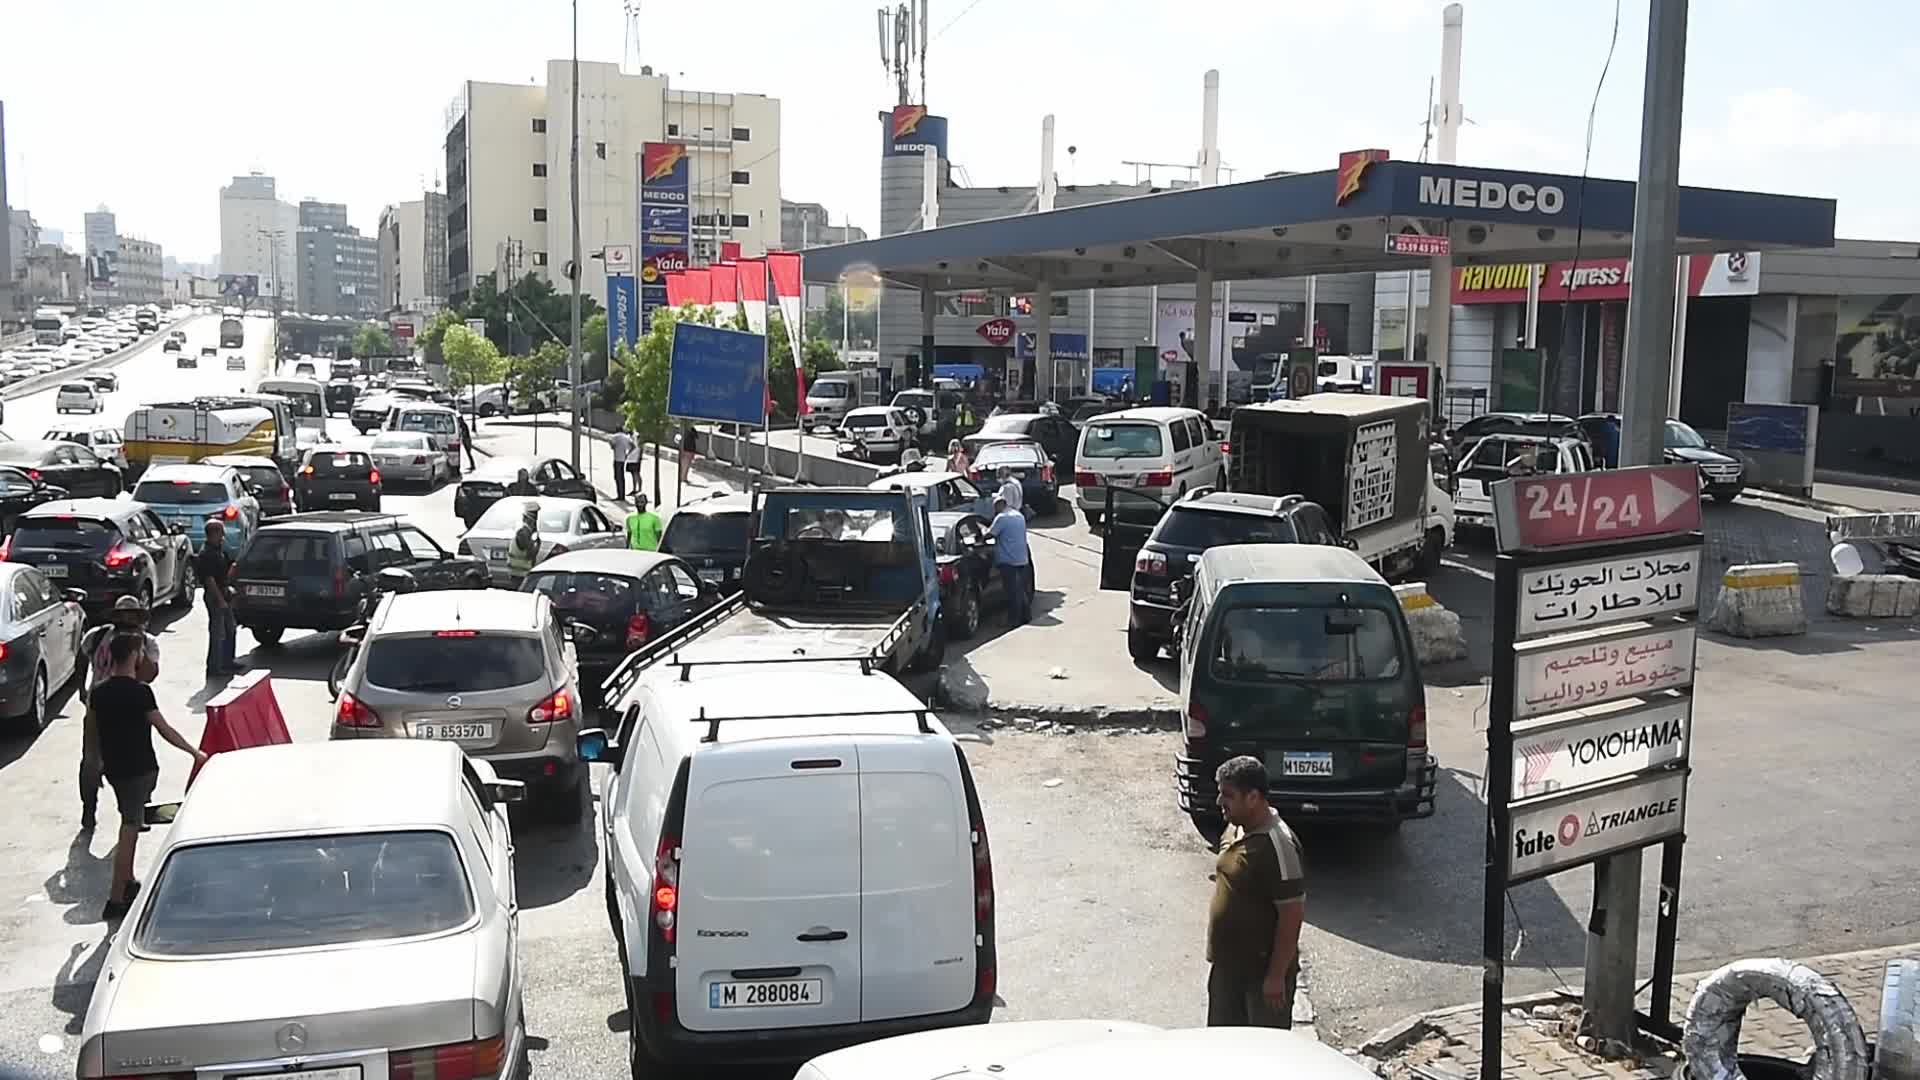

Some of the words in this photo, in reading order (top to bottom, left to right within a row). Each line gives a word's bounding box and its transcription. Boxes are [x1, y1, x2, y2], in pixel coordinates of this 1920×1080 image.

[894, 144, 928, 152] MEDC
[643, 191, 685, 201] MEDCO
[1419, 176, 1565, 214] MEDCO
[655, 257, 684, 270] Yala
[986, 324, 1009, 336] Yala
[1525, 477, 1642, 537] 24/24
[1619, 560, 1691, 582] محلات
[1544, 647, 1620, 678] وتلحيم
[1624, 639, 1673, 664] مبيع
[1615, 664, 1687, 687] جنوطة
[1524, 680, 1609, 711] ودواليب
[426, 726, 434, 738] B
[441, 725, 484, 737] 653570
[1568, 719, 1683, 767] YOKOHAMA
[1600, 798, 1678, 831] TRIANGLE
[724, 985, 736, 1004] M
[746, 982, 810, 1004] 288084
